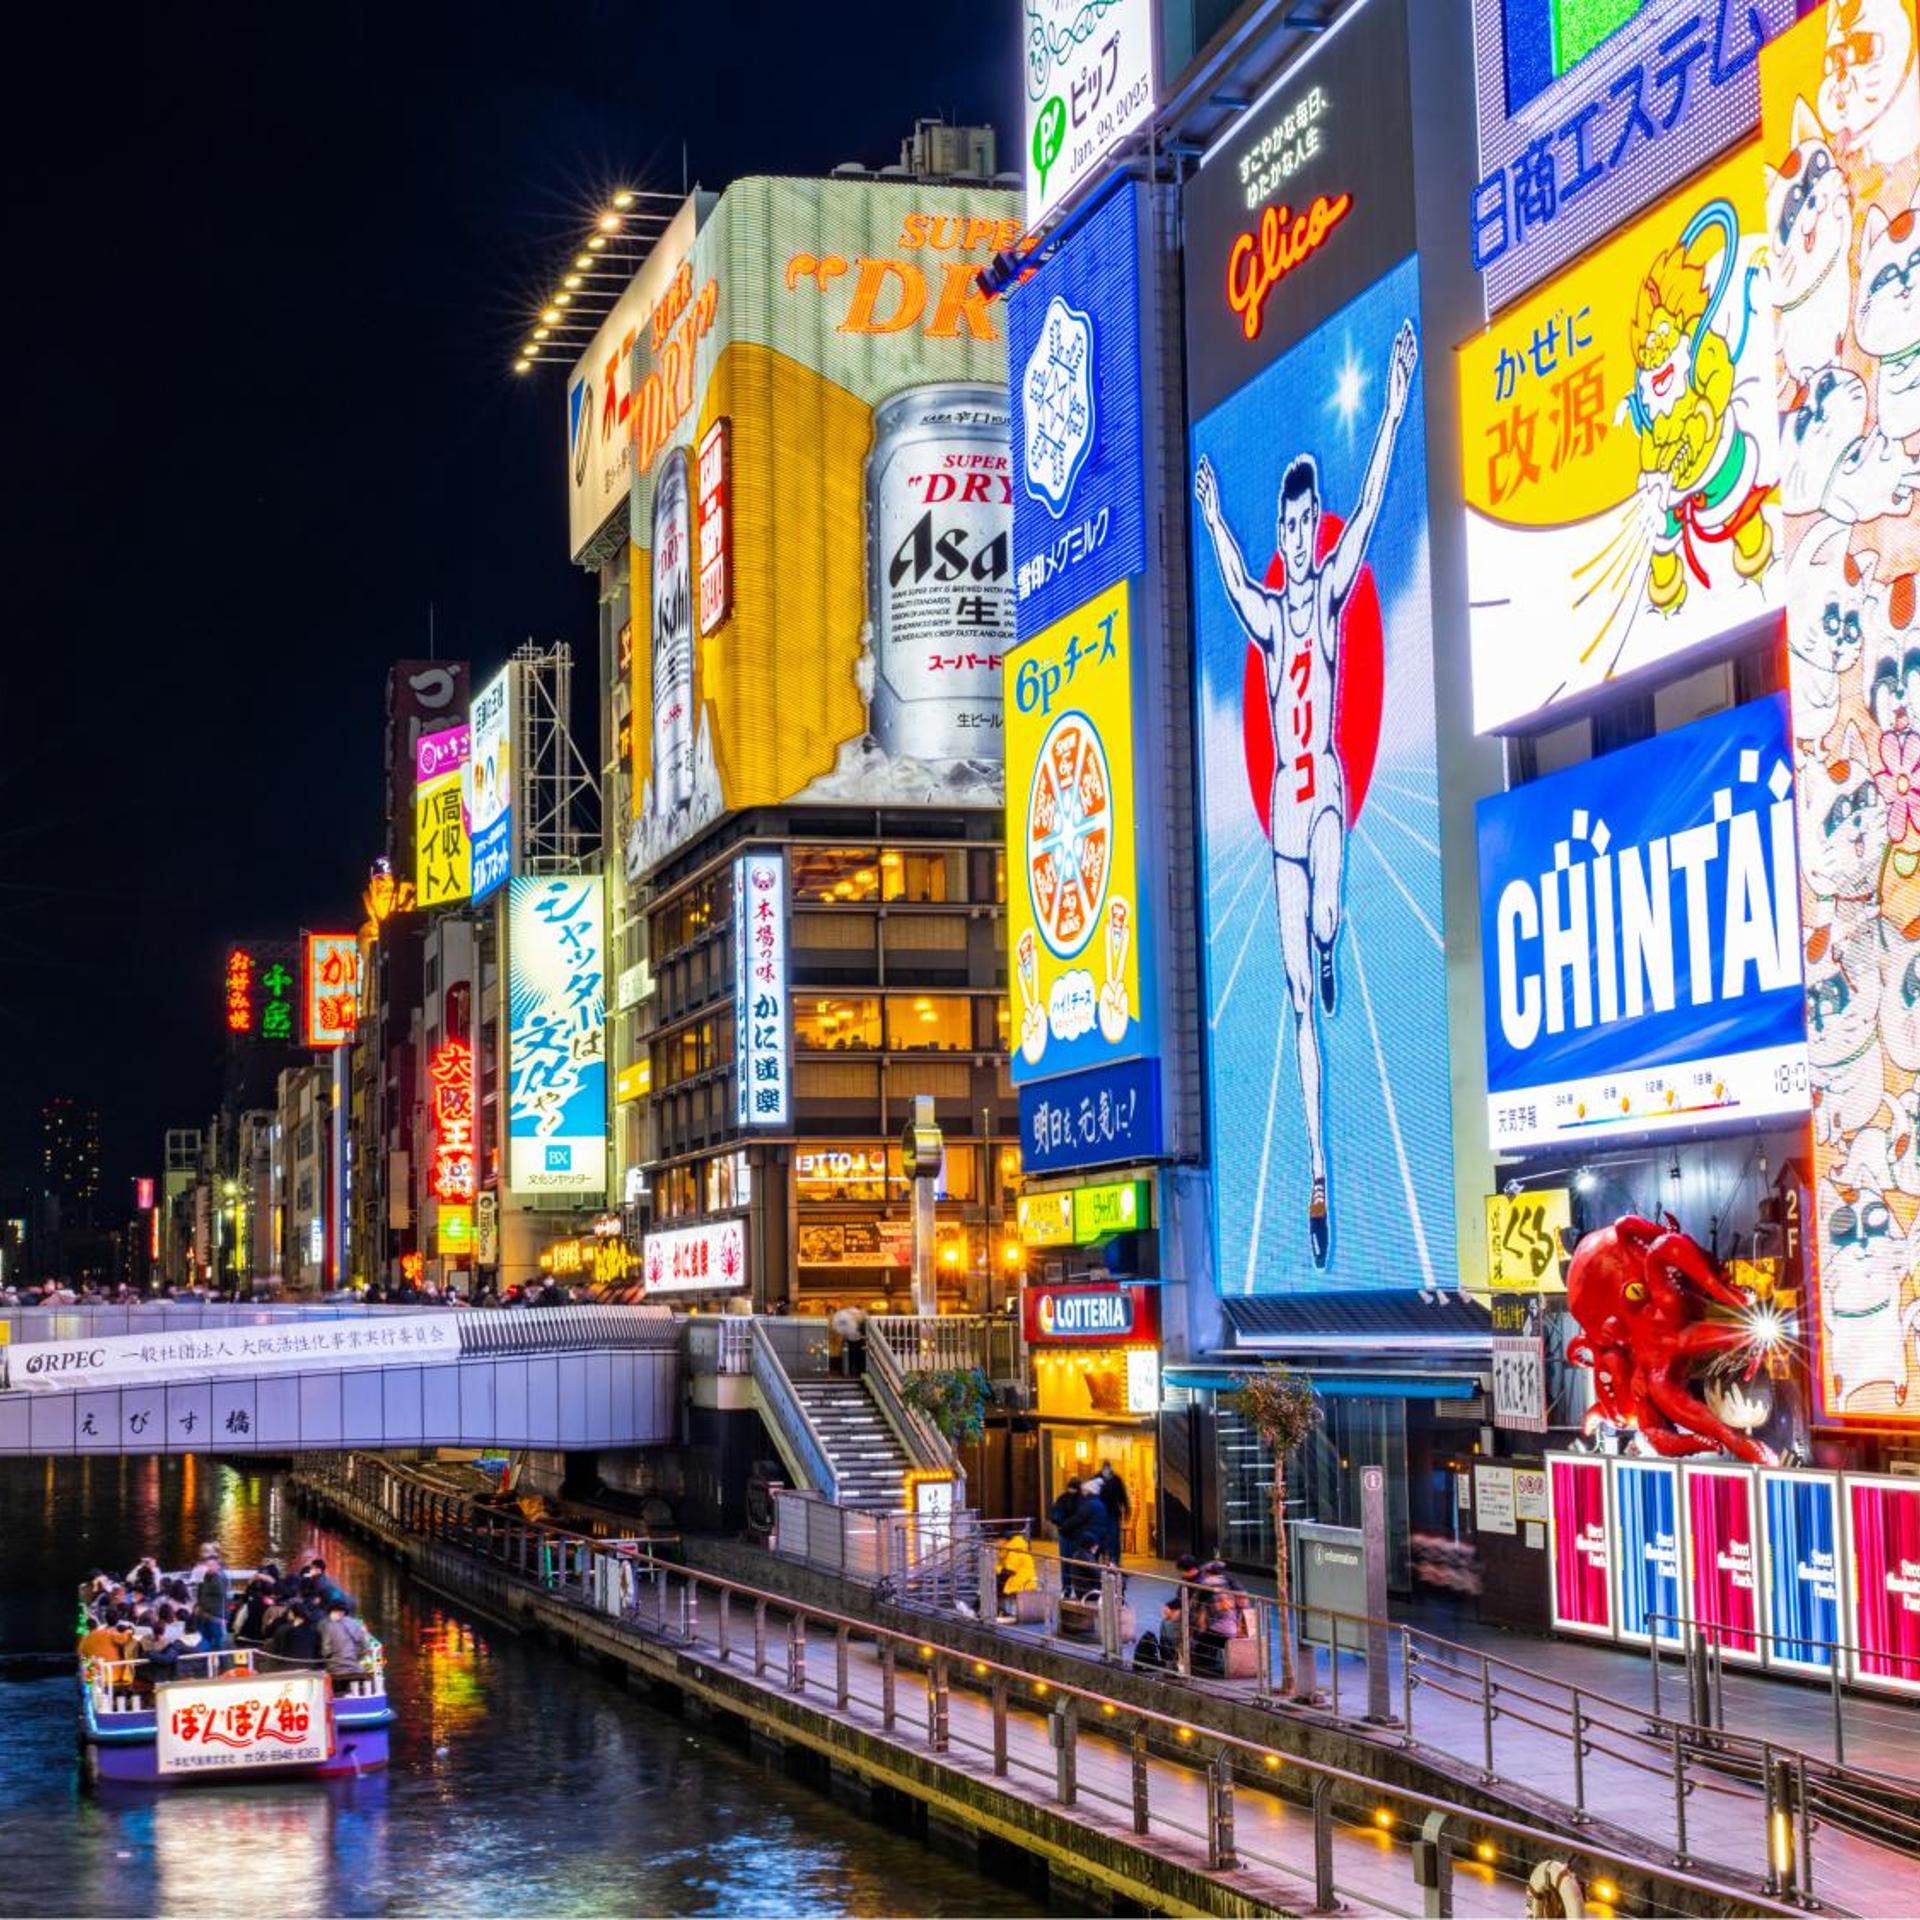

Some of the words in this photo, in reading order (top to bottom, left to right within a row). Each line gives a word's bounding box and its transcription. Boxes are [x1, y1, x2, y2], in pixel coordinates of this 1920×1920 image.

[1071, 30, 1120, 128] ピップ
[1071, 139, 1095, 174] Jan.
[1117, 74, 1149, 125] 2025
[1248, 127, 1319, 209] ゆたかな人生
[898, 210, 1038, 253] SUPE
[1228, 193, 1352, 340] Glico
[1494, 306, 1592, 402] かぜに
[943, 455, 1007, 470] SUPER
[1485, 354, 1608, 506] 改源
[1017, 507, 1108, 600] 雪印メグミルク
[956, 595, 1000, 627] 生
[1289, 638, 1316, 804] グリコ
[421, 792, 442, 900] バイト
[442, 787, 462, 893] 高収入
[754, 899, 776, 984] 本場の味
[1497, 747, 1801, 1051] CHINTAI
[430, 1042, 473, 1198] 大阪王将
[549, 1151, 568, 1165] BX
[1503, 1205, 1555, 1278] くくる
[1786, 1189, 1799, 1259] 2F
[121, 1341, 235, 1363] 一般社団法人
[241, 1325, 446, 1356] 大阪活性化事業実行委員会
[1056, 1296, 1126, 1329] LOTTERIA
[82, 1410, 250, 1436] えびす橋
[171, 1699, 310, 1749] ぽんぽん船
